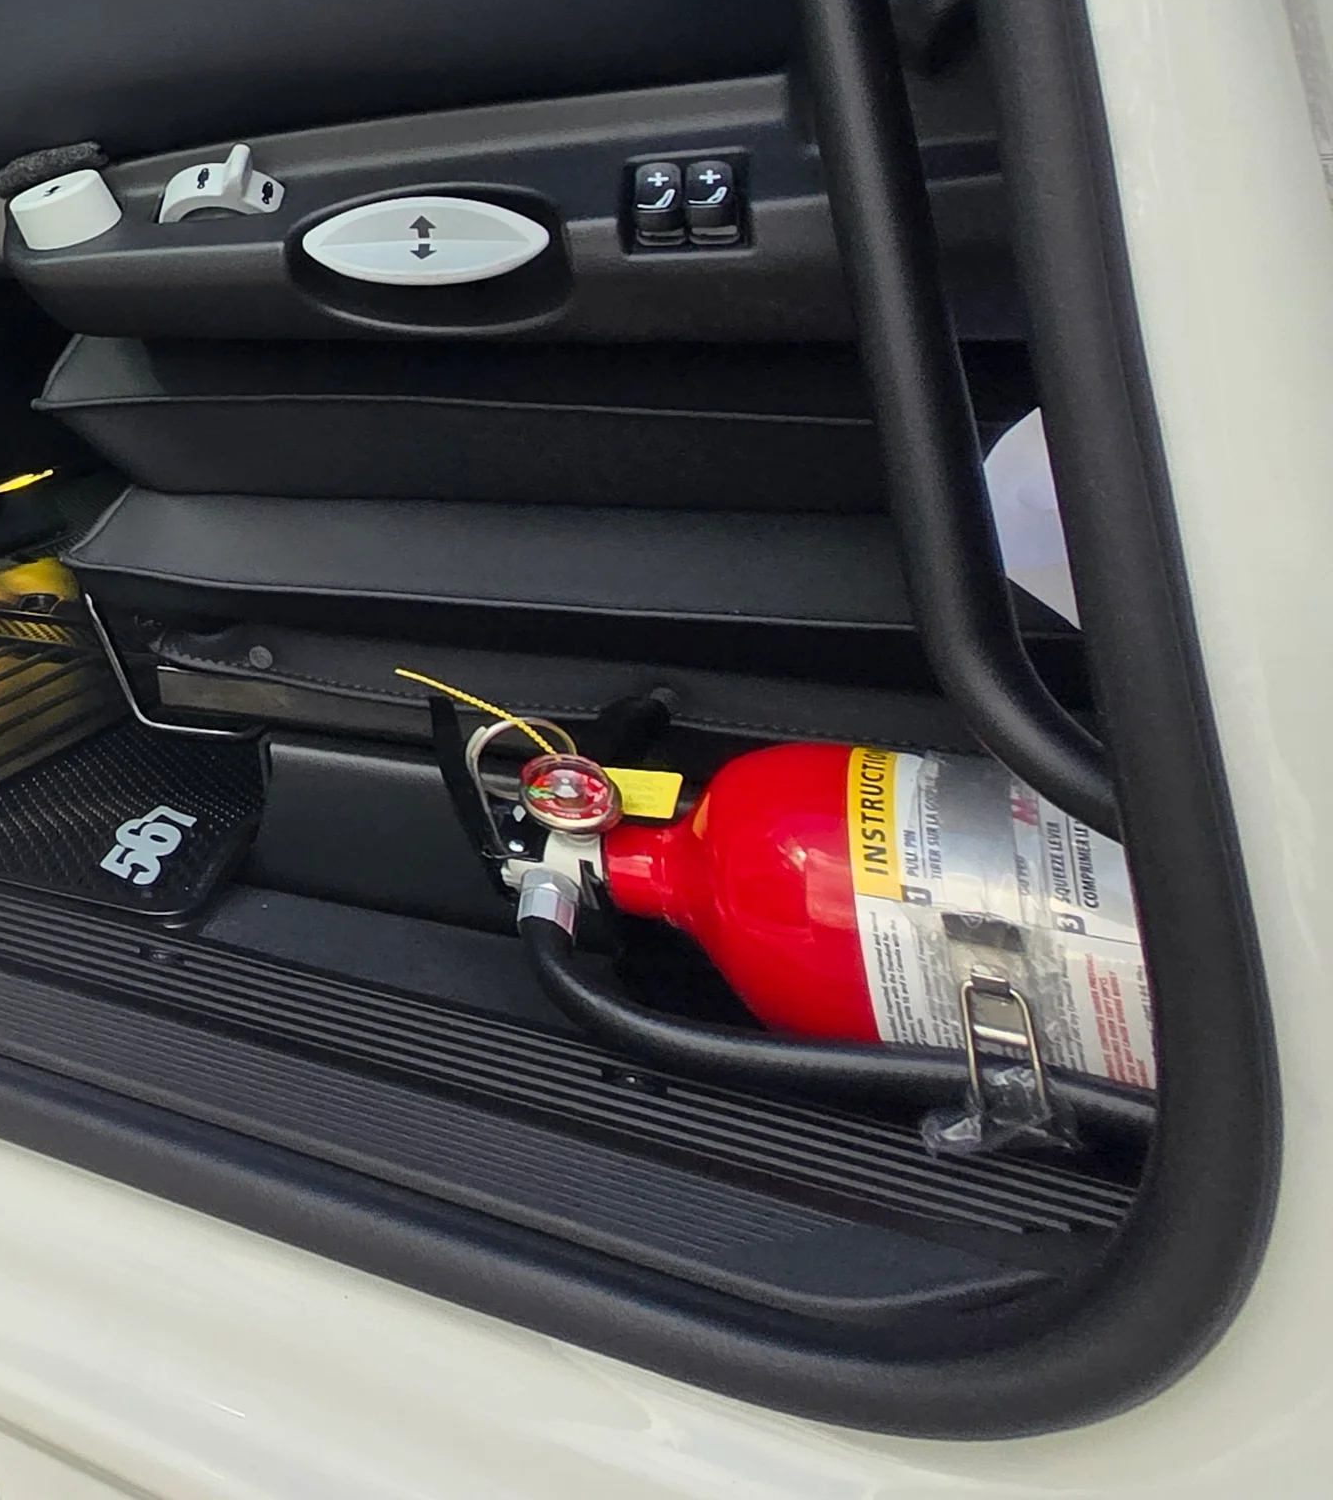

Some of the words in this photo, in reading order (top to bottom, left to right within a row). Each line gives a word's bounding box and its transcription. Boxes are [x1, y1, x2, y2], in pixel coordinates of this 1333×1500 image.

[859, 749, 890, 876] INSTRUCTIO
[99, 804, 198, 885] 567
[904, 830, 916, 848] PIN
[926, 828, 939, 846] SUR
[1046, 821, 1064, 851] LEVER
[905, 852, 919, 877] PULL
[1049, 853, 1071, 903] SQUEEZE
[1074, 841, 1099, 909] COMPRIMER
[907, 891, 926, 900] 1
[1058, 917, 1079, 929] 3
